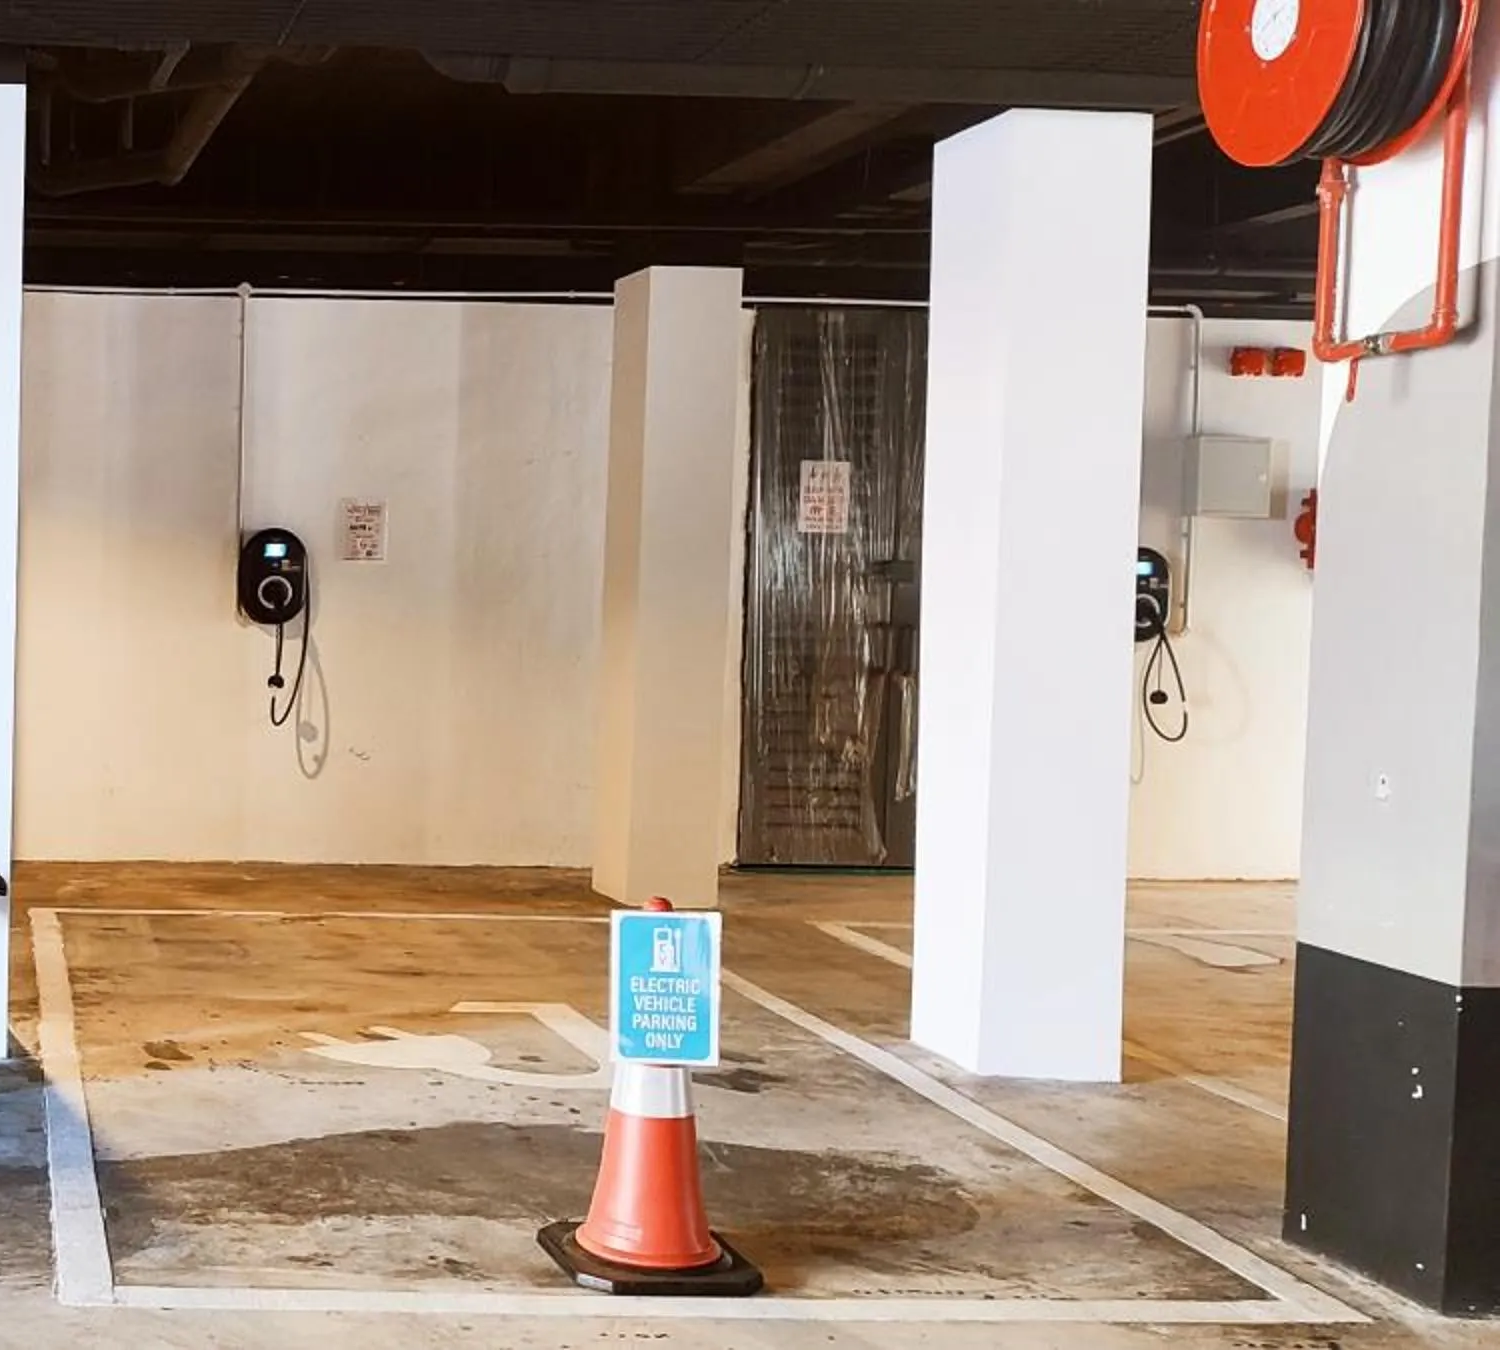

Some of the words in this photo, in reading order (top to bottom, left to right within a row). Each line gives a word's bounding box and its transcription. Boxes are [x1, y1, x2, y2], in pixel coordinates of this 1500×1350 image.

[630, 976, 701, 994] ELECTRIC
[634, 995, 697, 1012] VEHICLE
[632, 1014, 697, 1031] PARKING
[645, 1032, 685, 1049] ONLY
